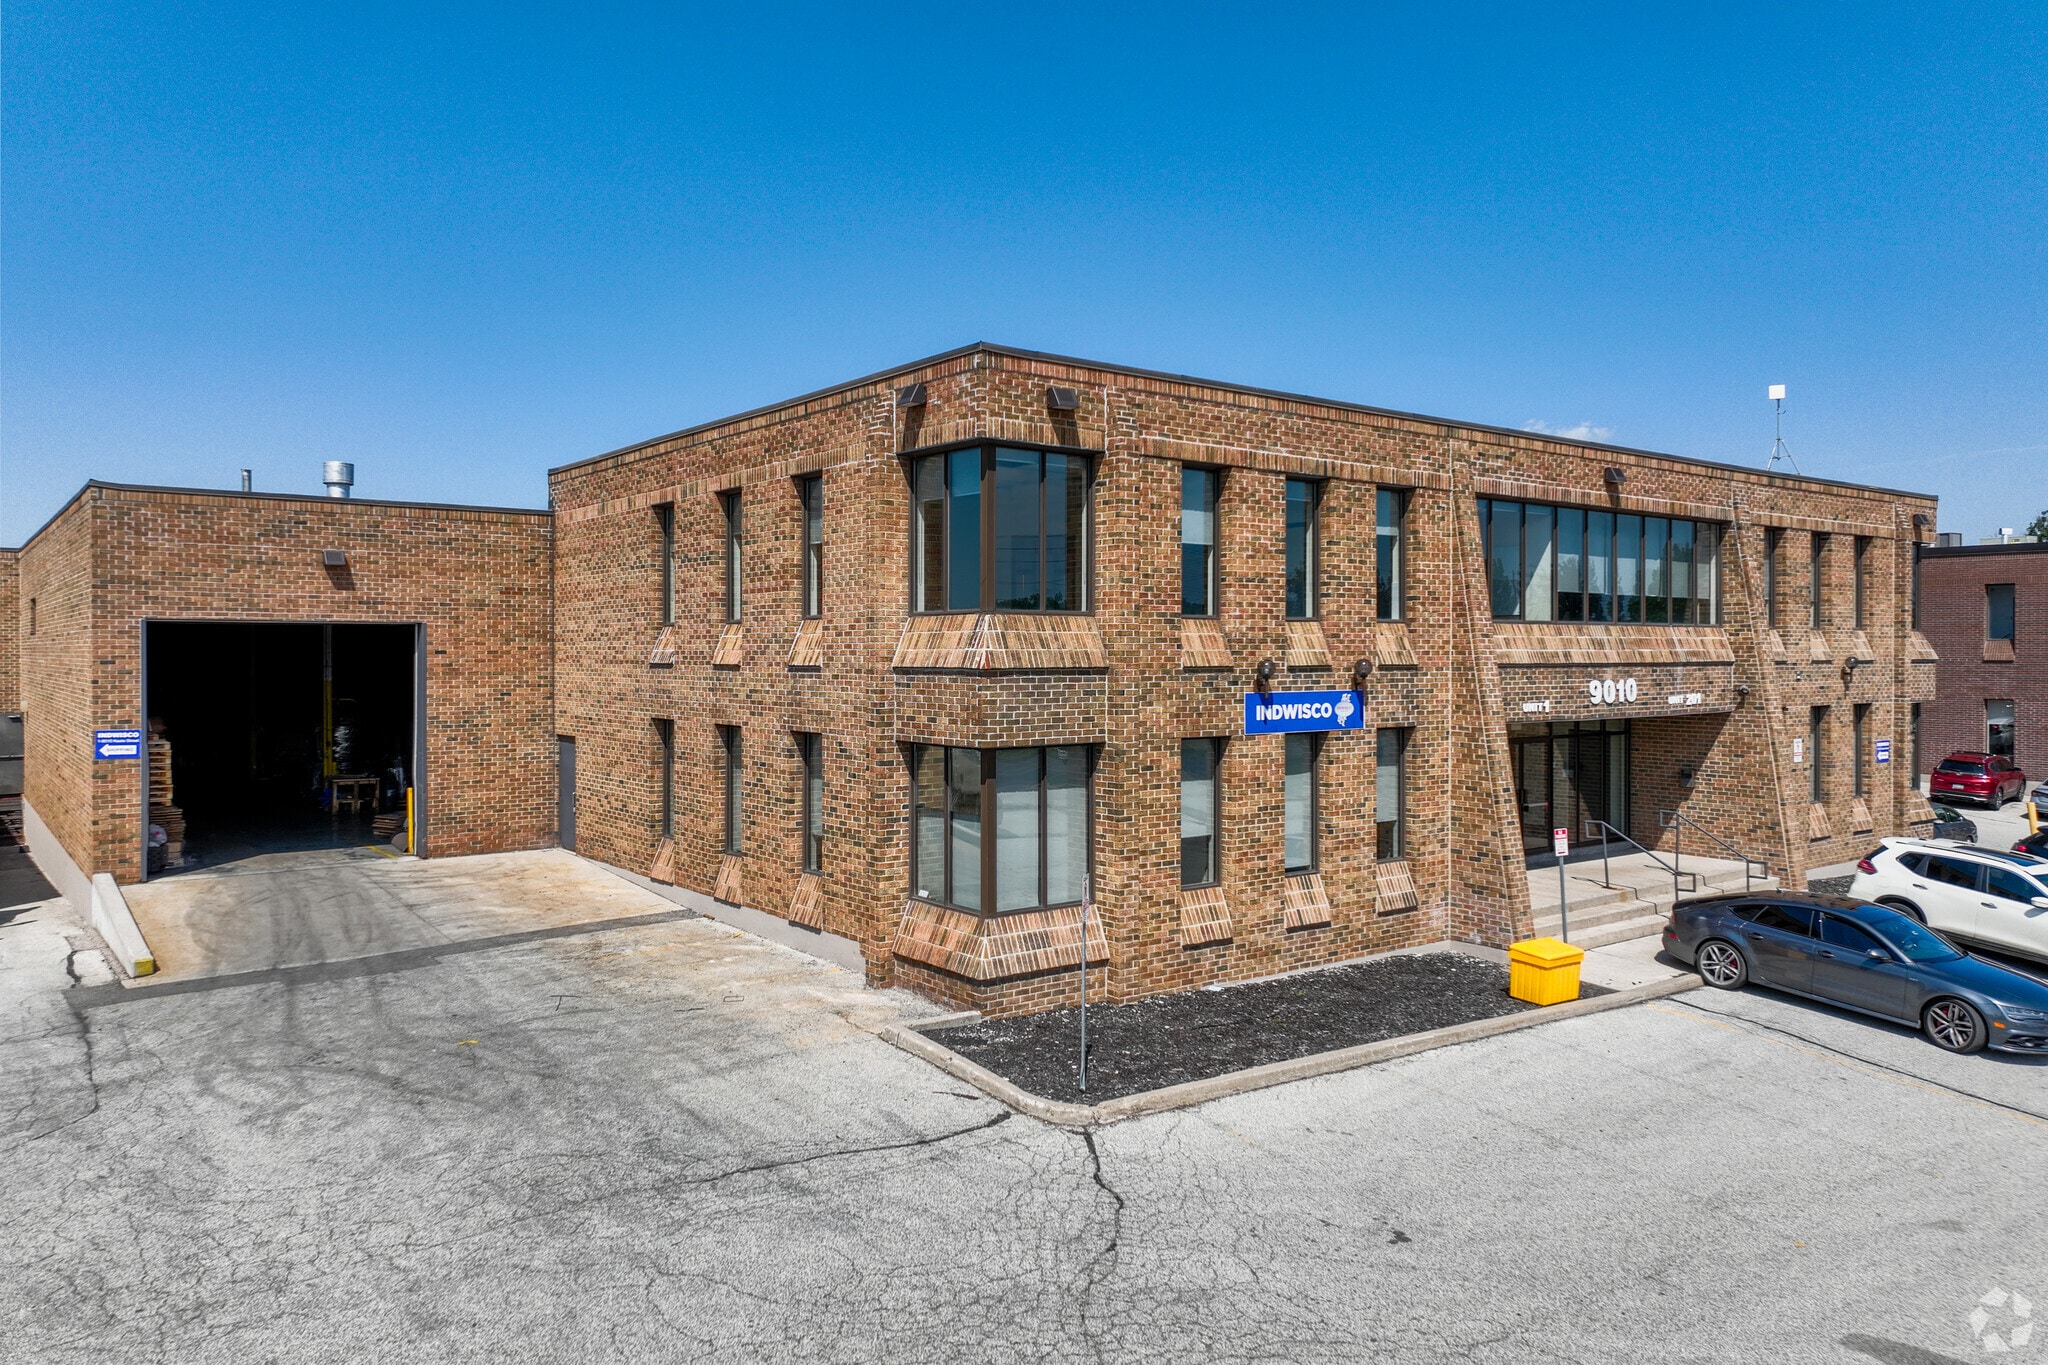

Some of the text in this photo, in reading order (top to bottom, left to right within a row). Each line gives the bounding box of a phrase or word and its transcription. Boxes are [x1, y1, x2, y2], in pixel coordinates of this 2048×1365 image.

[1589, 678, 1637, 704] 9010
[1256, 702, 1332, 721] INDWISCO
[1522, 702, 1544, 713] UNIT
